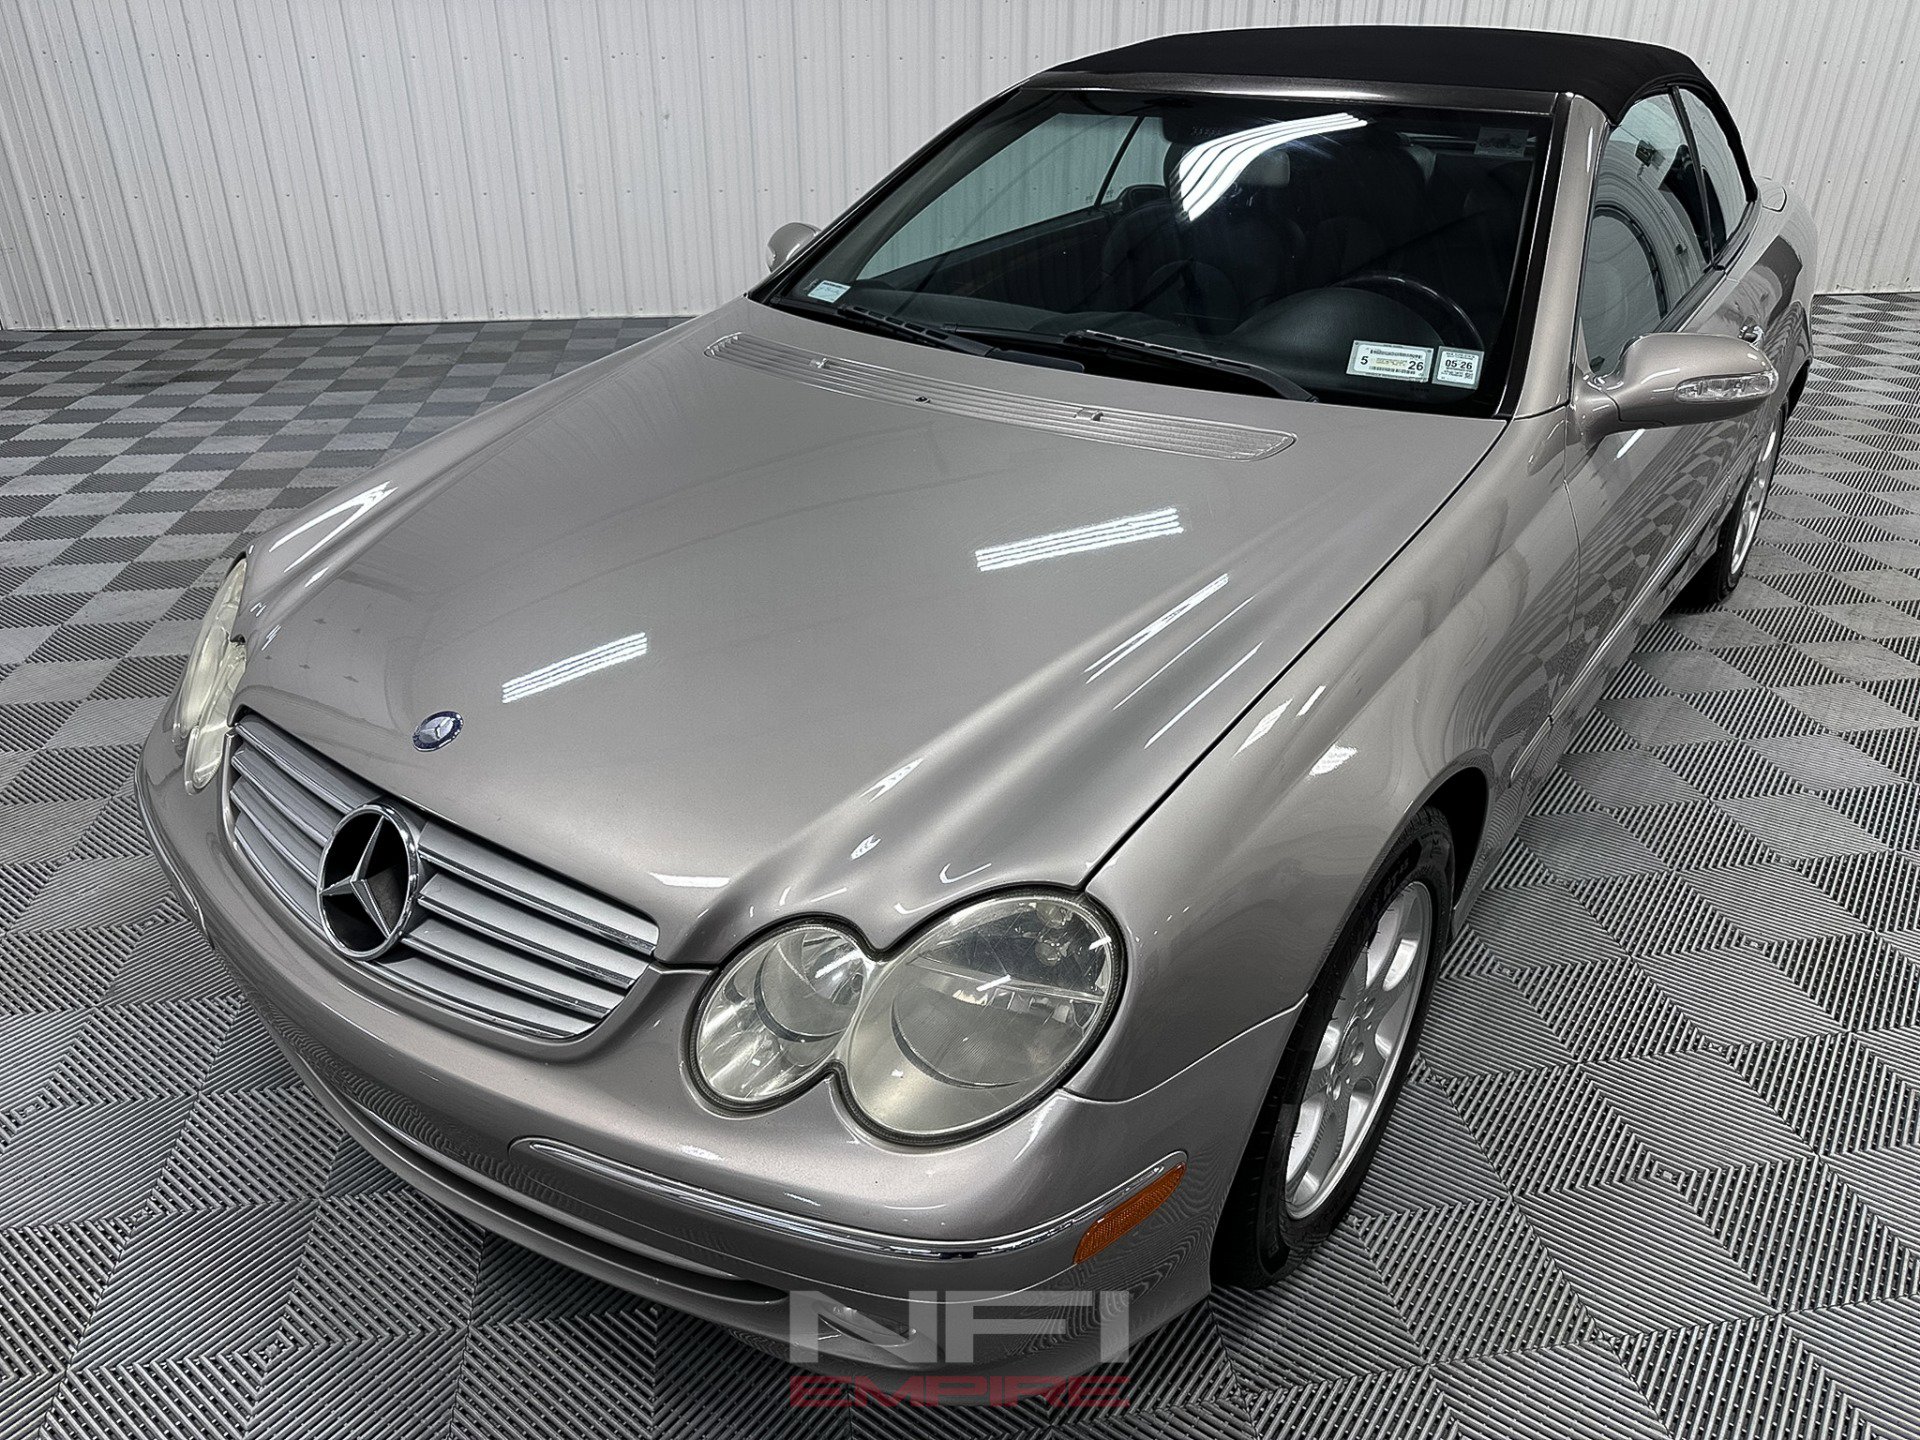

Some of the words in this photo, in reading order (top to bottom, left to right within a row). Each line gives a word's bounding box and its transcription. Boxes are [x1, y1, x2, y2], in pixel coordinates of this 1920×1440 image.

[1360, 356, 1369, 366] 5
[1408, 361, 1424, 371] 26
[1445, 359, 1458, 368] 05
[1460, 361, 1473, 370] 26
